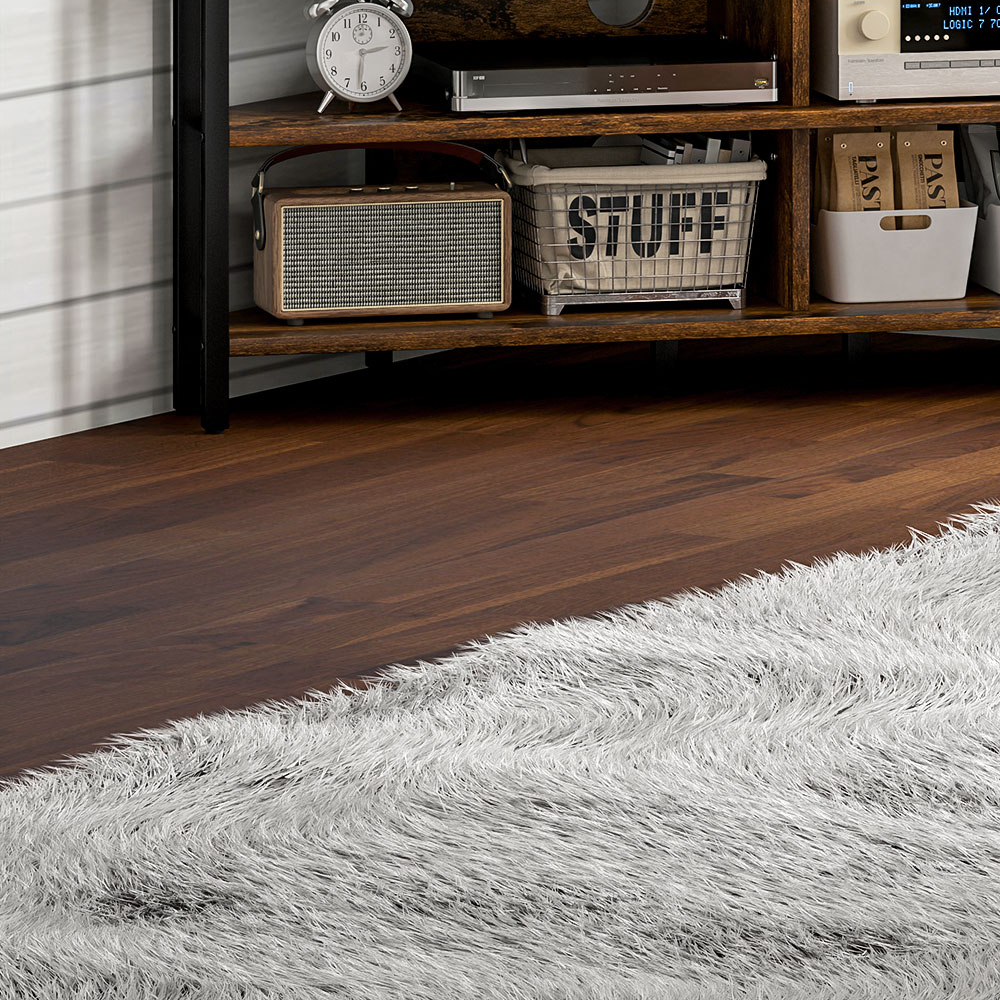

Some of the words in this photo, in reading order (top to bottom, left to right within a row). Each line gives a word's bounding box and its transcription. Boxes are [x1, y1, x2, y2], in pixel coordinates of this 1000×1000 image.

[949, 6, 972, 16] HDMI
[358, 13, 367, 23] 12
[343, 19, 351, 28] 11
[943, 19, 973, 30] LOGIC
[979, 19, 985, 28] 7
[331, 32, 340, 41] 10
[389, 29, 396, 39] 2
[325, 49, 332, 59] 9
[394, 46, 401, 56] 3
[331, 66, 337, 76] 8
[389, 63, 396, 73] 4
[344, 78, 350, 88] 7
[360, 81, 367, 91] 6
[379, 76, 386, 86] 5
[568, 191, 729, 259] STUFF
